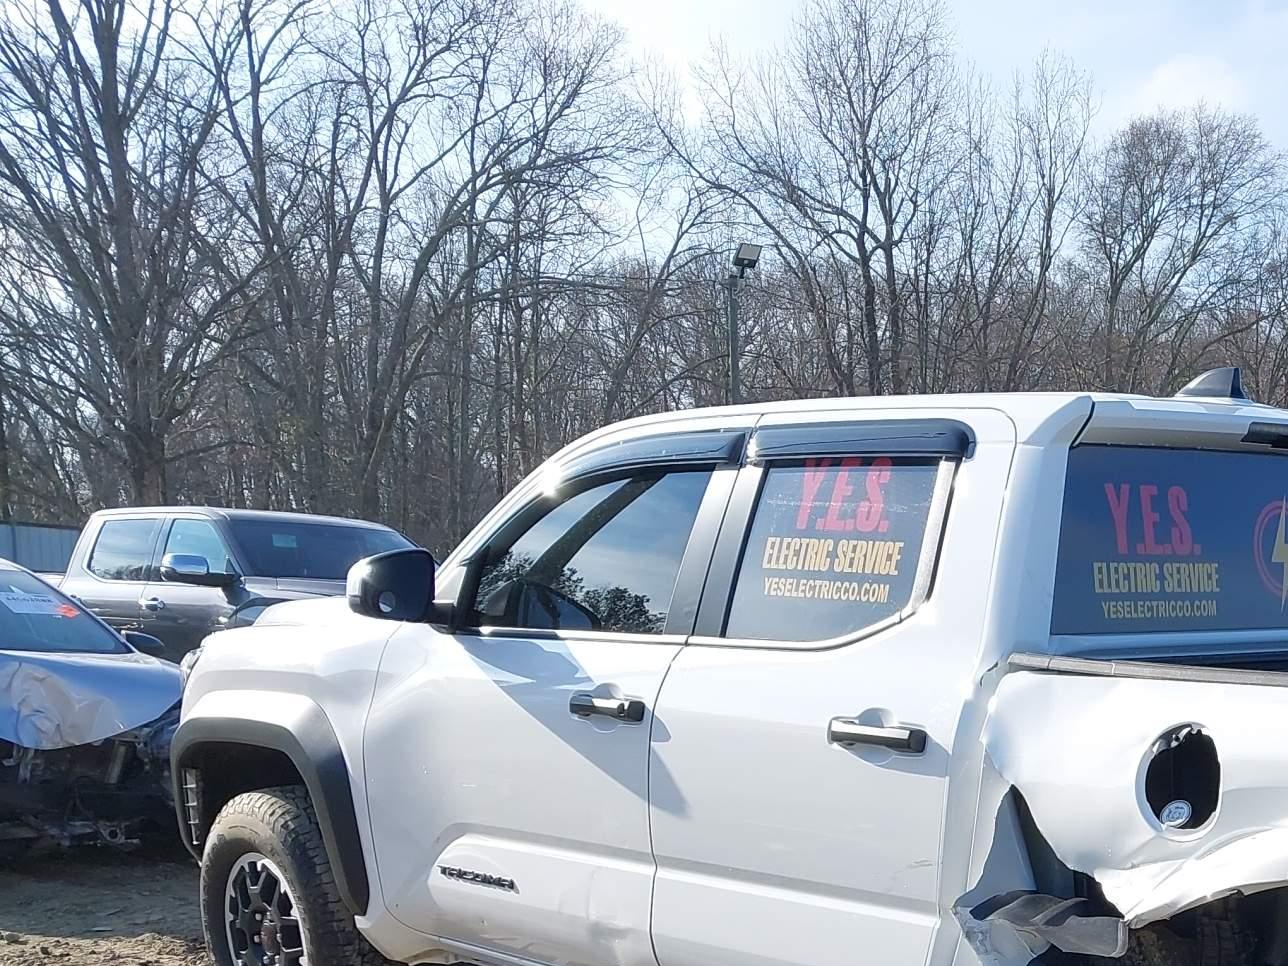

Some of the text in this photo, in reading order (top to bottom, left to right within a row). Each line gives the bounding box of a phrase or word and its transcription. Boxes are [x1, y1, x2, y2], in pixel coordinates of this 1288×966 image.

[796, 457, 892, 533] Y.E.S.
[1103, 483, 1202, 555] Y.E.S.
[762, 537, 904, 575] ELECTRIC SERVICE
[764, 577, 889, 603] YESELECTRICCO.COM
[1093, 562, 1220, 593] ELECTRIC SERVICE
[1101, 600, 1217, 619] YESELECTRICCO.COM
